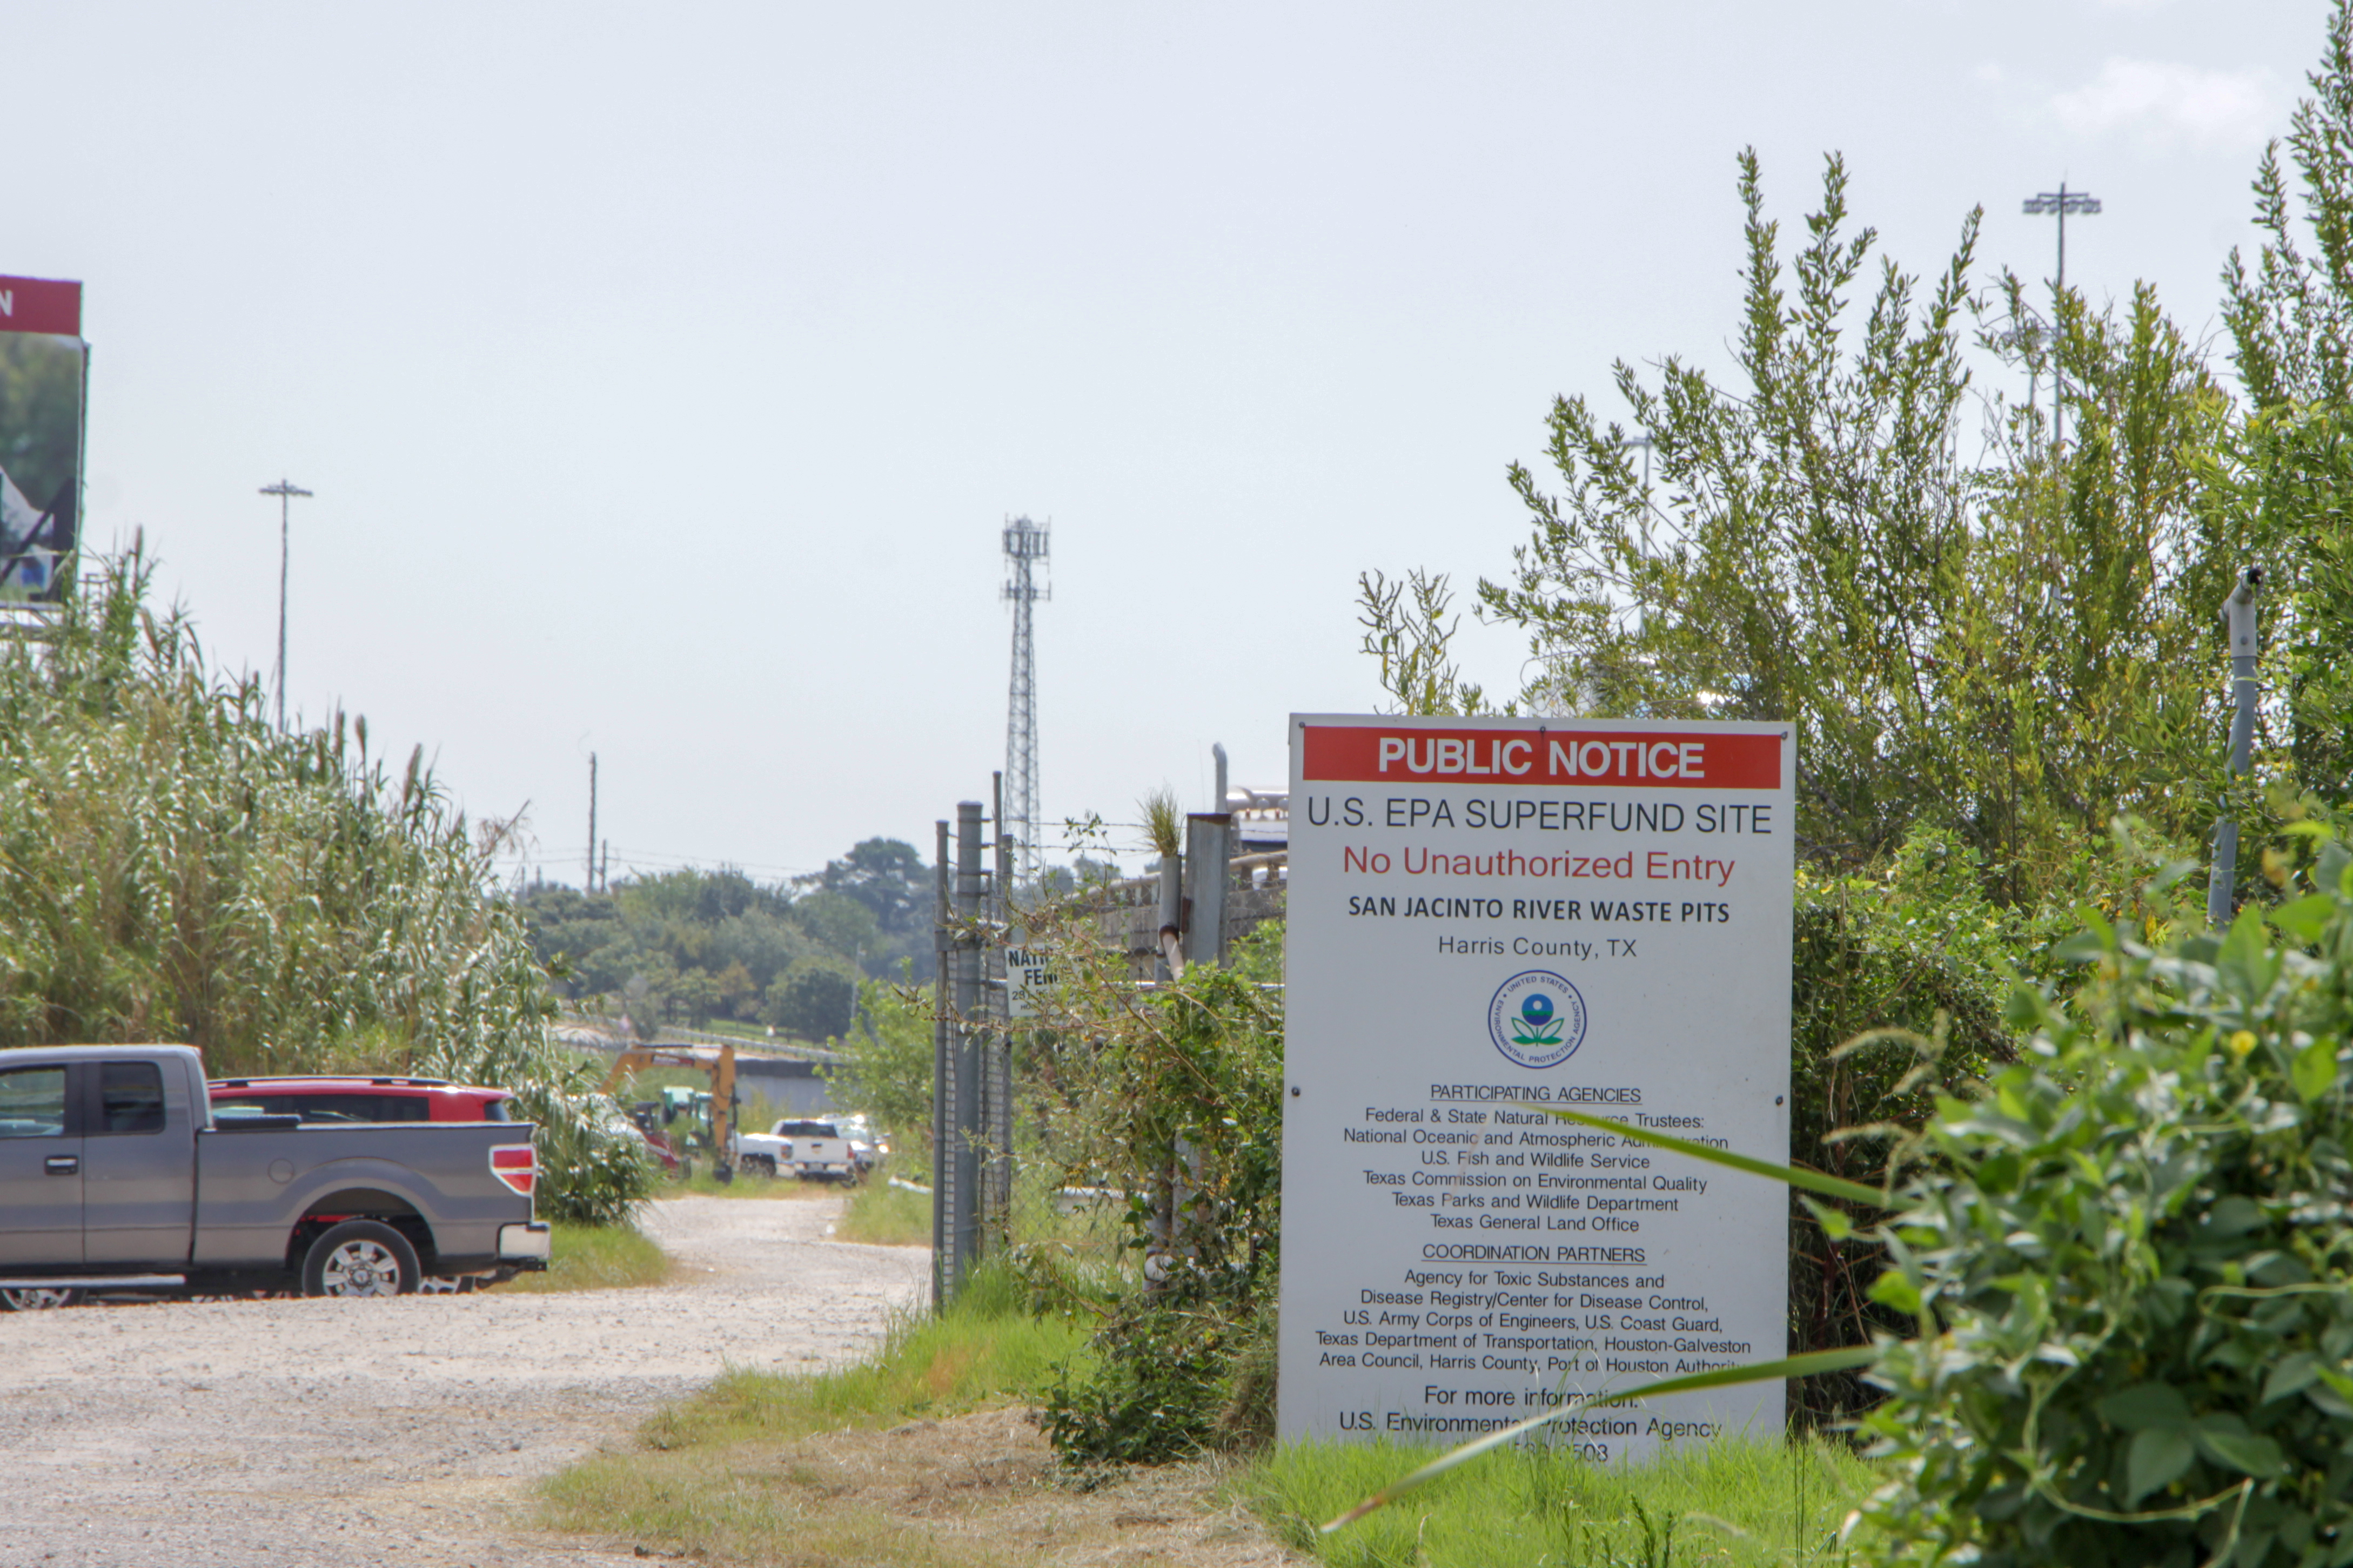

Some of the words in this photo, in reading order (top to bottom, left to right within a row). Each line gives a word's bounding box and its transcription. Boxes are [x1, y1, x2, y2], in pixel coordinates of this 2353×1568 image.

[1379, 737, 1532, 775] PUBLIC
[1550, 741, 1704, 778] NOTICE
[1309, 797, 1372, 826] U.S.
[1387, 798, 1454, 827] EPA
[1466, 799, 1684, 832] SUPERFUND
[1697, 804, 1771, 833] SITE
[1345, 846, 1390, 873] No
[1405, 847, 1632, 878] Unauthorized
[1647, 852, 1735, 887] Entry
[1349, 896, 1395, 916] SAN
[1404, 898, 1503, 918] JACINTO
[1514, 900, 1581, 920] RIVER
[1591, 901, 1671, 921] WASTE
[1682, 903, 1729, 923] PITS
[1439, 936, 1504, 954] Harris
[1513, 937, 1598, 960] County,
[1607, 939, 1636, 957] TX
[1507, 976, 1537, 992] UNITED
[1540, 976, 1568, 993] STATES
[1494, 999, 1525, 1060] ENVIRONMENTAL
[1529, 1036, 1576, 1063] PROTECTION
[1571, 1001, 1581, 1035] AGENCY
[1431, 1085, 1550, 1100] PARTICIPATING
[1558, 1087, 1641, 1102] AGENCIES
[1366, 1108, 1423, 1122] Federal
[1431, 1109, 1441, 1122] &
[1449, 1109, 1486, 1123] State
[1495, 1111, 1548, 1125] Natural
[1635, 1113, 1704, 1128] Trustees:
[1344, 1128, 1406, 1143] National
[1413, 1129, 1478, 1145] Oceanic
[1484, 1132, 1512, 1145] and
[1519, 1131, 1615, 1149] Atmospheric
[1422, 1150, 1449, 1165] U.S.
[1458, 1151, 1489, 1165] Fish
[1496, 1153, 1524, 1166] and
[1531, 1153, 1584, 1167] Wildlife
[1591, 1154, 1650, 1168] Service
[1363, 1170, 1405, 1185] Texas
[1412, 1172, 1506, 1187] Commission
[1513, 1176, 1531, 1187] on
[1539, 1174, 1646, 1189] Environmental
[1653, 1176, 1707, 1194] Quality
[1392, 1192, 1434, 1207] Texas
[1442, 1193, 1484, 1207] Parks
[1491, 1194, 1520, 1208] and
[1526, 1195, 1579, 1209] Wildlife
[1587, 1196, 1678, 1214] Department
[1431, 1214, 1473, 1228] Texas
[1480, 1214, 1539, 1229] General
[1548, 1216, 1585, 1230] Land
[1592, 1217, 1639, 1231] Office
[1423, 1244, 1549, 1260] COORDINATION
[1558, 1247, 1645, 1262] PARTNERS
[1405, 1269, 1463, 1288] Agency
[1469, 1271, 1488, 1284] for
[1494, 1271, 1531, 1286] Toxic
[1538, 1272, 1628, 1288] Substances
[1636, 1273, 1664, 1288] and
[1362, 1289, 1423, 1304] Disease
[1431, 1291, 1548, 1309] Registry/Center
[1554, 1293, 1573, 1307] for
[1581, 1294, 1642, 1309] Disease
[1649, 1295, 1707, 1313] Control,
[1344, 1310, 1371, 1325] U.S.
[1379, 1311, 1419, 1329] Army
[1426, 1312, 1472, 1330] Corps
[1479, 1313, 1493, 1327] of
[1500, 1313, 1579, 1331] Engineers,
[1586, 1315, 1613, 1329] U.S.
[1621, 1316, 1666, 1330] Coast
[1672, 1317, 1722, 1333] Guard,
[1316, 1331, 1358, 1345] Texas
[1366, 1332, 1457, 1349] Department
[1464, 1334, 1477, 1348] of
[1483, 1334, 1597, 1352] Transportation,
[1605, 1337, 1751, 1353] Houston-Galveston
[1319, 1352, 1356, 1367] Area
[1362, 1352, 1422, 1370] Council,
[1431, 1355, 1476, 1369] Harris
[1483, 1355, 1540, 1374] County,
[1548, 1357, 1579, 1371] Port
[1586, 1357, 1599, 1371] of
[1607, 1358, 1668, 1372] Houston
[1425, 1386, 1457, 1404] For
[1466, 1391, 1515, 1405] more
[1340, 1412, 1376, 1430] U.S.
[1539, 1417, 1637, 1435] rotection
[1646, 1418, 1721, 1441] Agency
